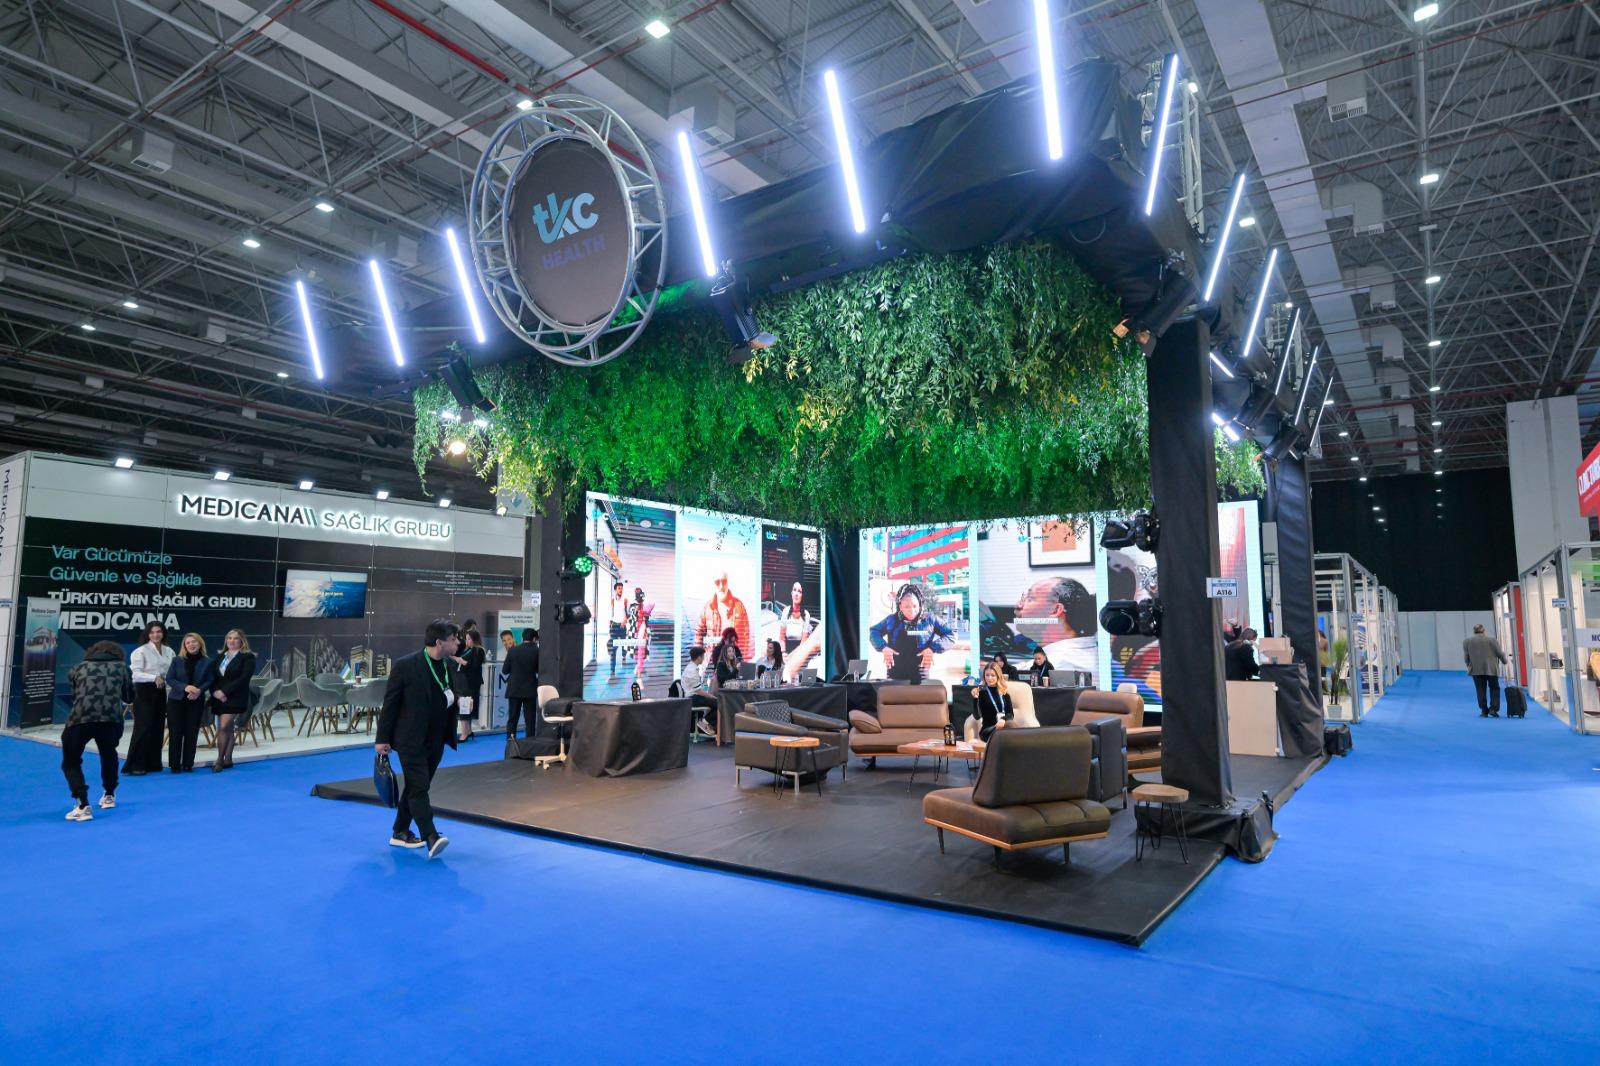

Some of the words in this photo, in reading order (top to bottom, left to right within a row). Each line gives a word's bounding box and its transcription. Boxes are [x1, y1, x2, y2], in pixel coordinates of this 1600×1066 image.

[532, 192, 599, 244] tkc
[542, 233, 606, 271] HEALTH
[181, 494, 305, 525] MEDICANA
[323, 512, 390, 533] SAĞLIK
[394, 520, 451, 538] GRUBU
[51, 545, 79, 560] Var
[85, 548, 172, 565] Gücümüzle
[50, 566, 119, 583] Güvenle
[124, 572, 142, 584] ve
[146, 571, 202, 589] Sağlıkla
[152, 592, 205, 607] SAĞLIK
[208, 596, 256, 608] GRUBU
